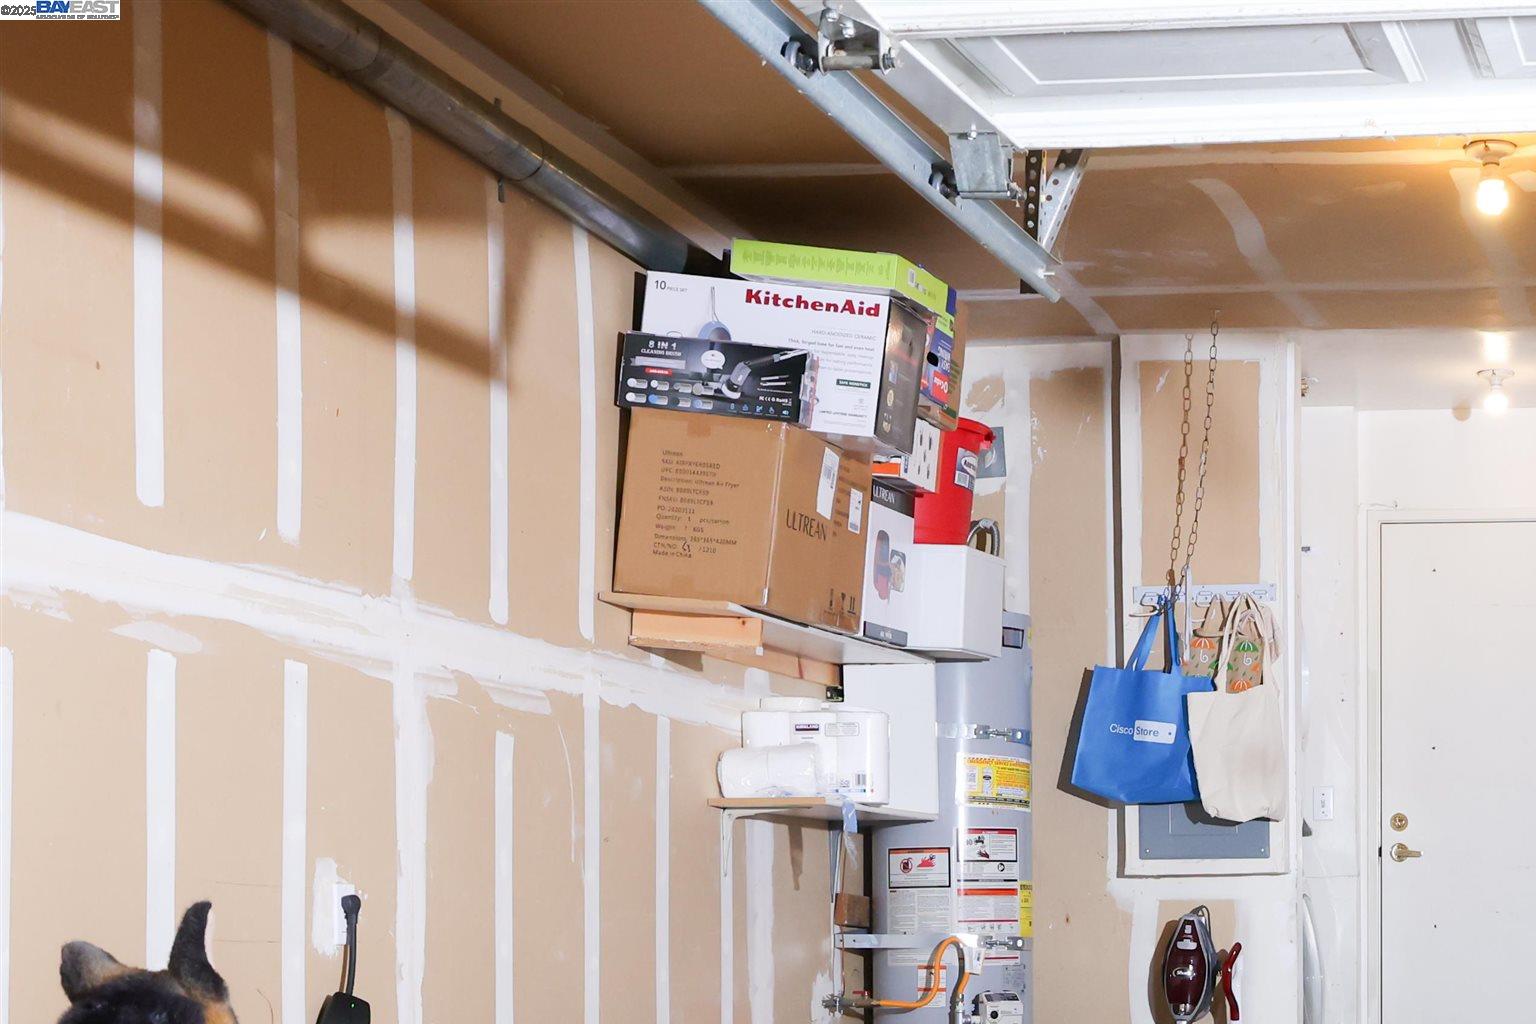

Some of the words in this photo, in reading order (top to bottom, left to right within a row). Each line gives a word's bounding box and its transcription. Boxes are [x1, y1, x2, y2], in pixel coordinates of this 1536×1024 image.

[654, 280, 667, 290] 10
[745, 288, 881, 318] KitchenAid
[648, 340, 655, 348] 8
[657, 341, 670, 350] IN
[671, 342, 677, 351] 1
[872, 484, 896, 504] ULTREAN
[786, 508, 828, 542] ULTREAN
[1110, 723, 1134, 735] Cisco
[1136, 726, 1160, 737] Store
